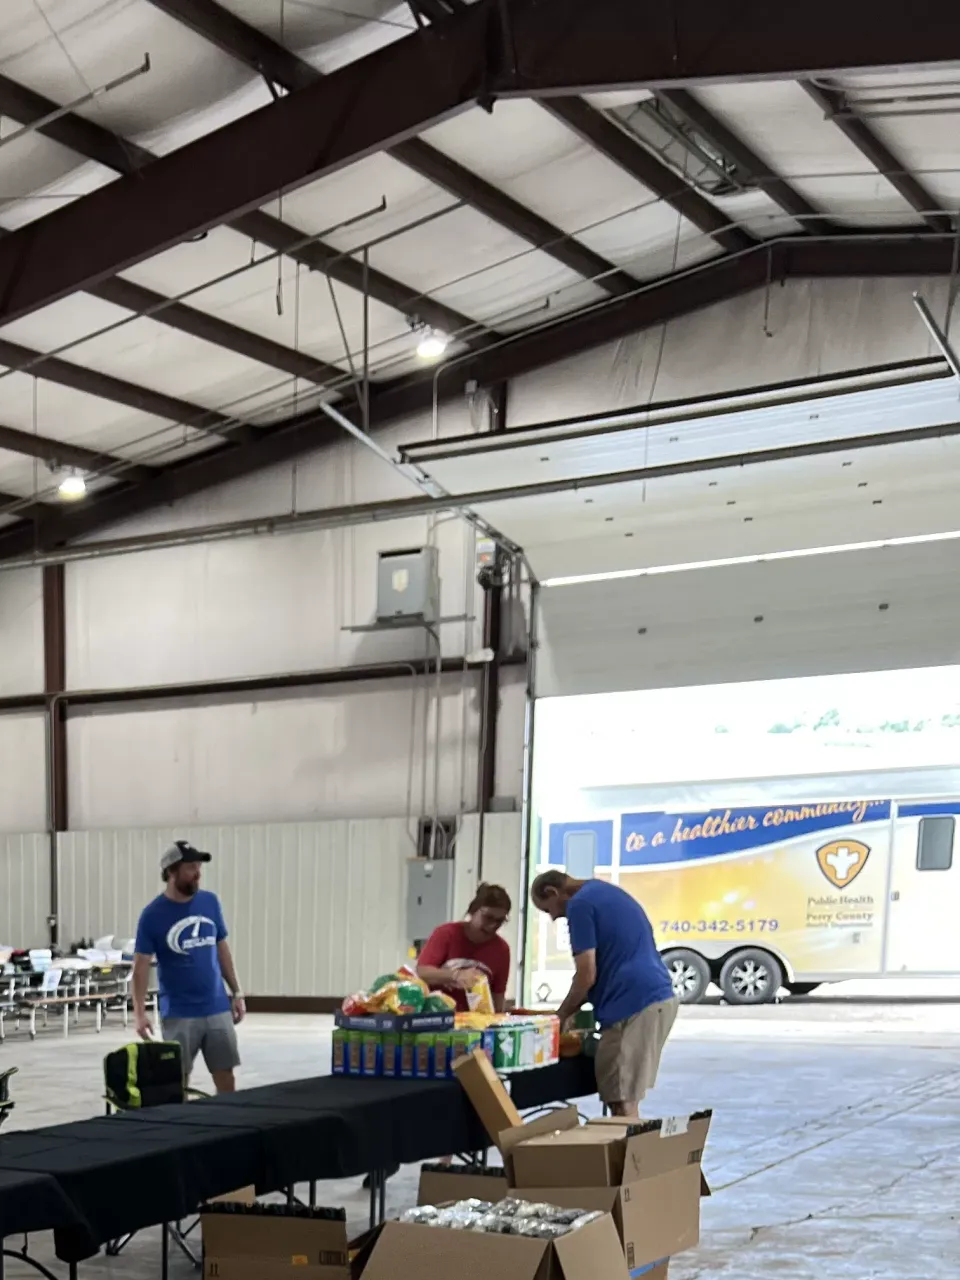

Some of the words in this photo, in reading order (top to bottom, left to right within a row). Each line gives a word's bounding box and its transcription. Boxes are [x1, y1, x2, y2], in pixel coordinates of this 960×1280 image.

[625, 832, 647, 852] to
[652, 831, 666, 847] a
[670, 809, 759, 844] healthier
[807, 895, 837, 904] Public
[840, 895, 874, 904] Health
[806, 913, 833, 922] Perry
[836, 912, 873, 921] County
[660, 919, 779, 933] 740-342-5179
